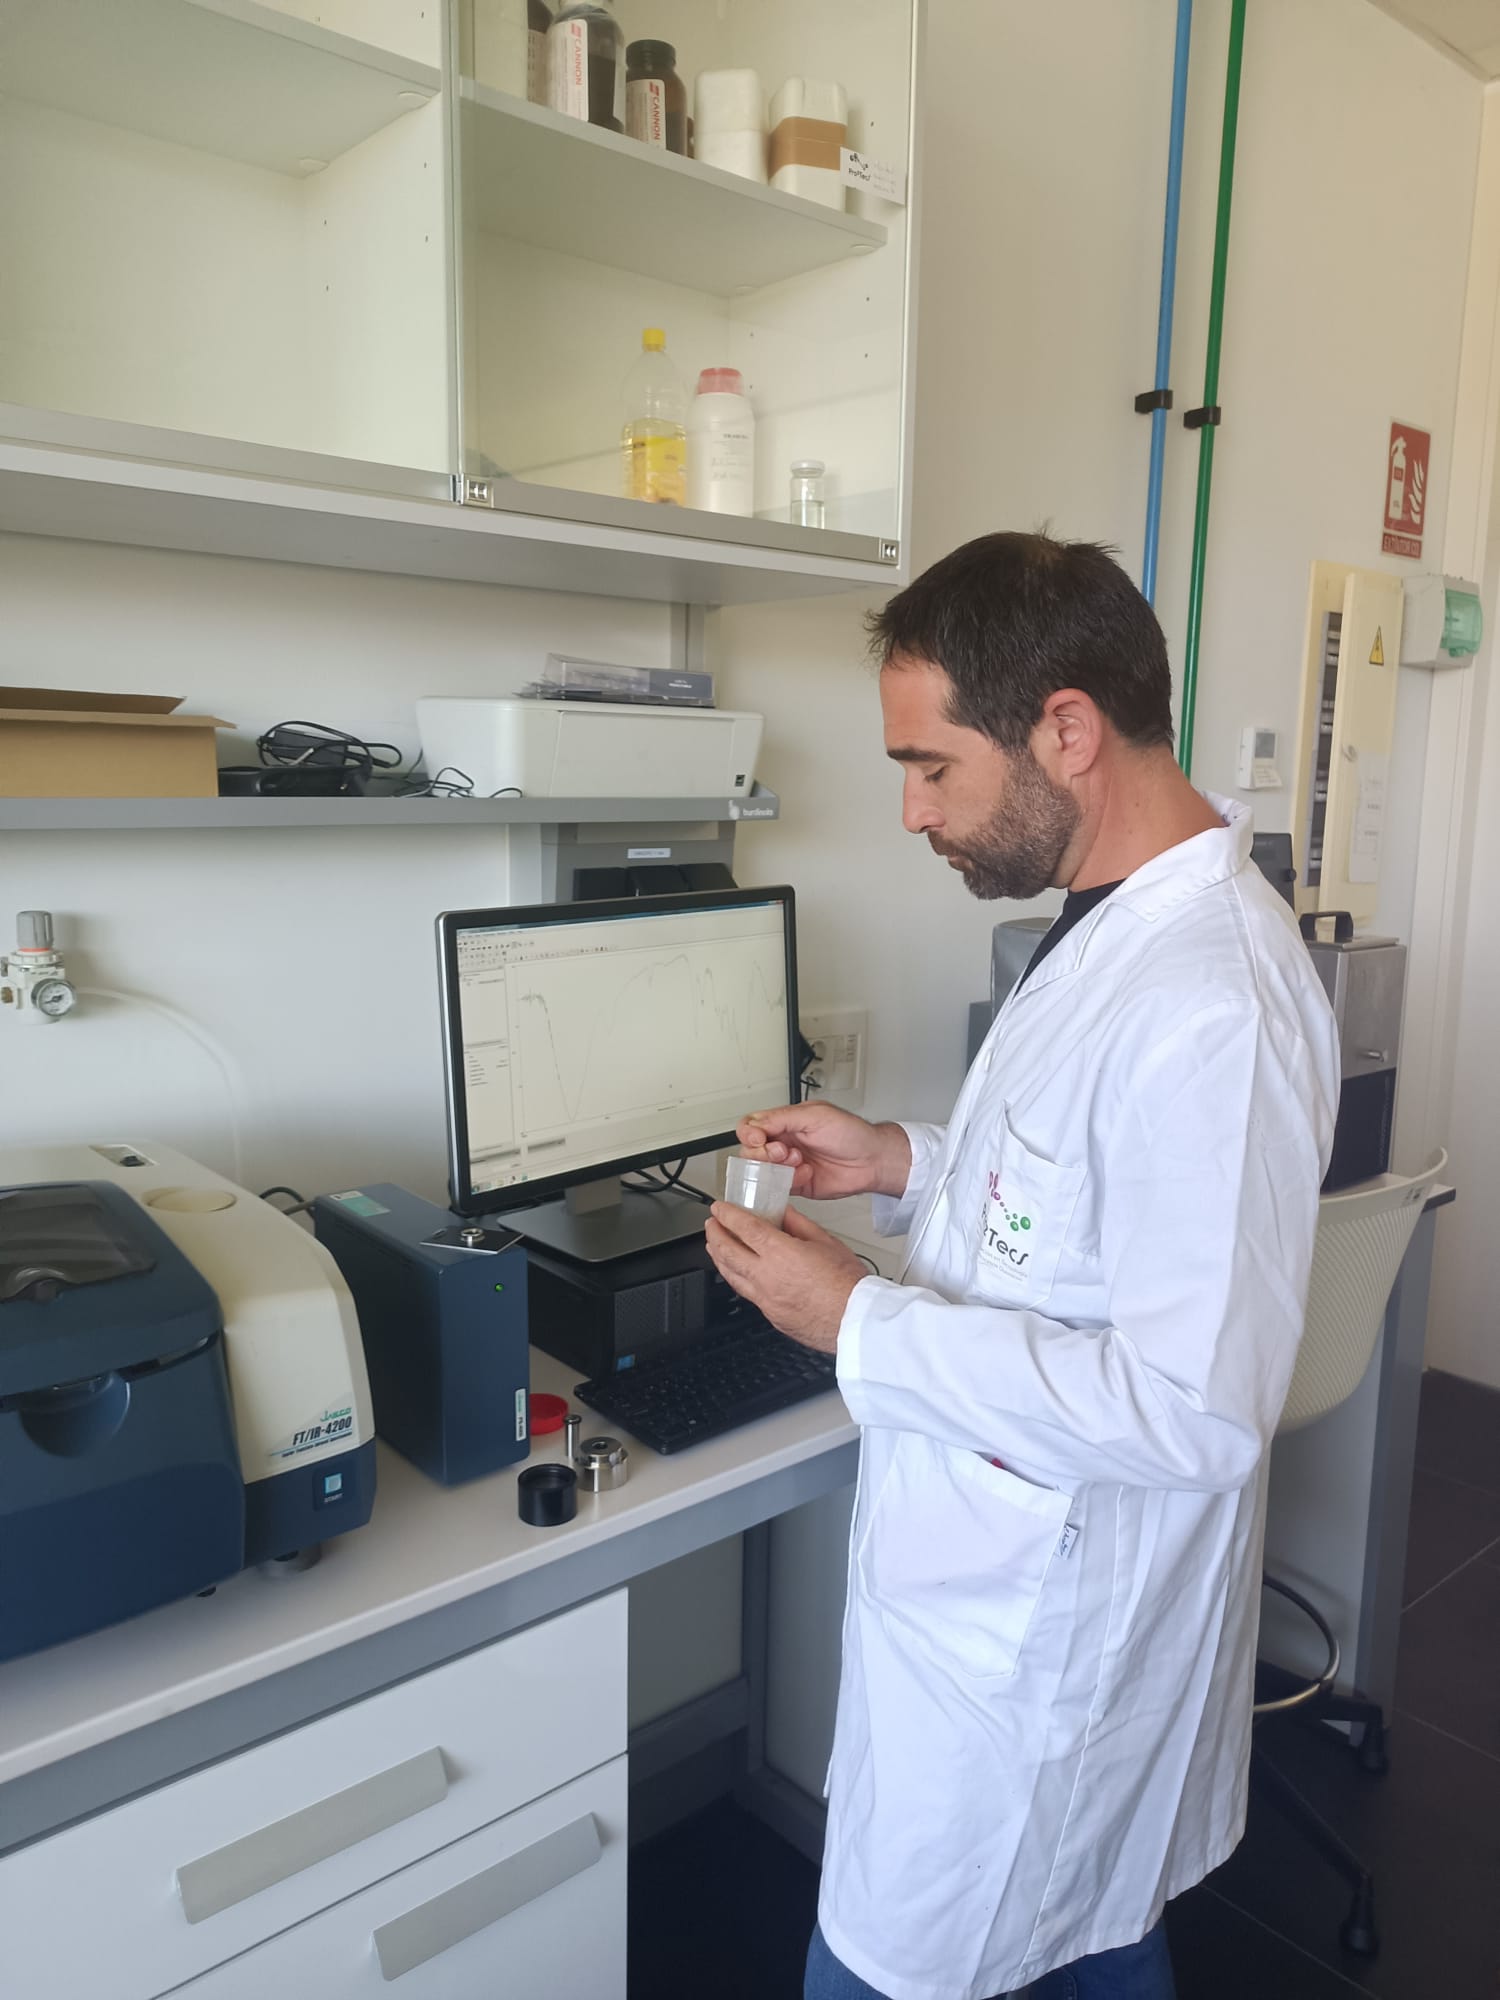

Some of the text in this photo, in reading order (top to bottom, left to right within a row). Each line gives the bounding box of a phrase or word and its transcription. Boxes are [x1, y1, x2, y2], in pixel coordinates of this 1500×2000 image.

[575, 38, 583, 86] CANNON
[653, 96, 661, 140] CANNON
[292, 1416, 353, 1446] FT/IR-4200
